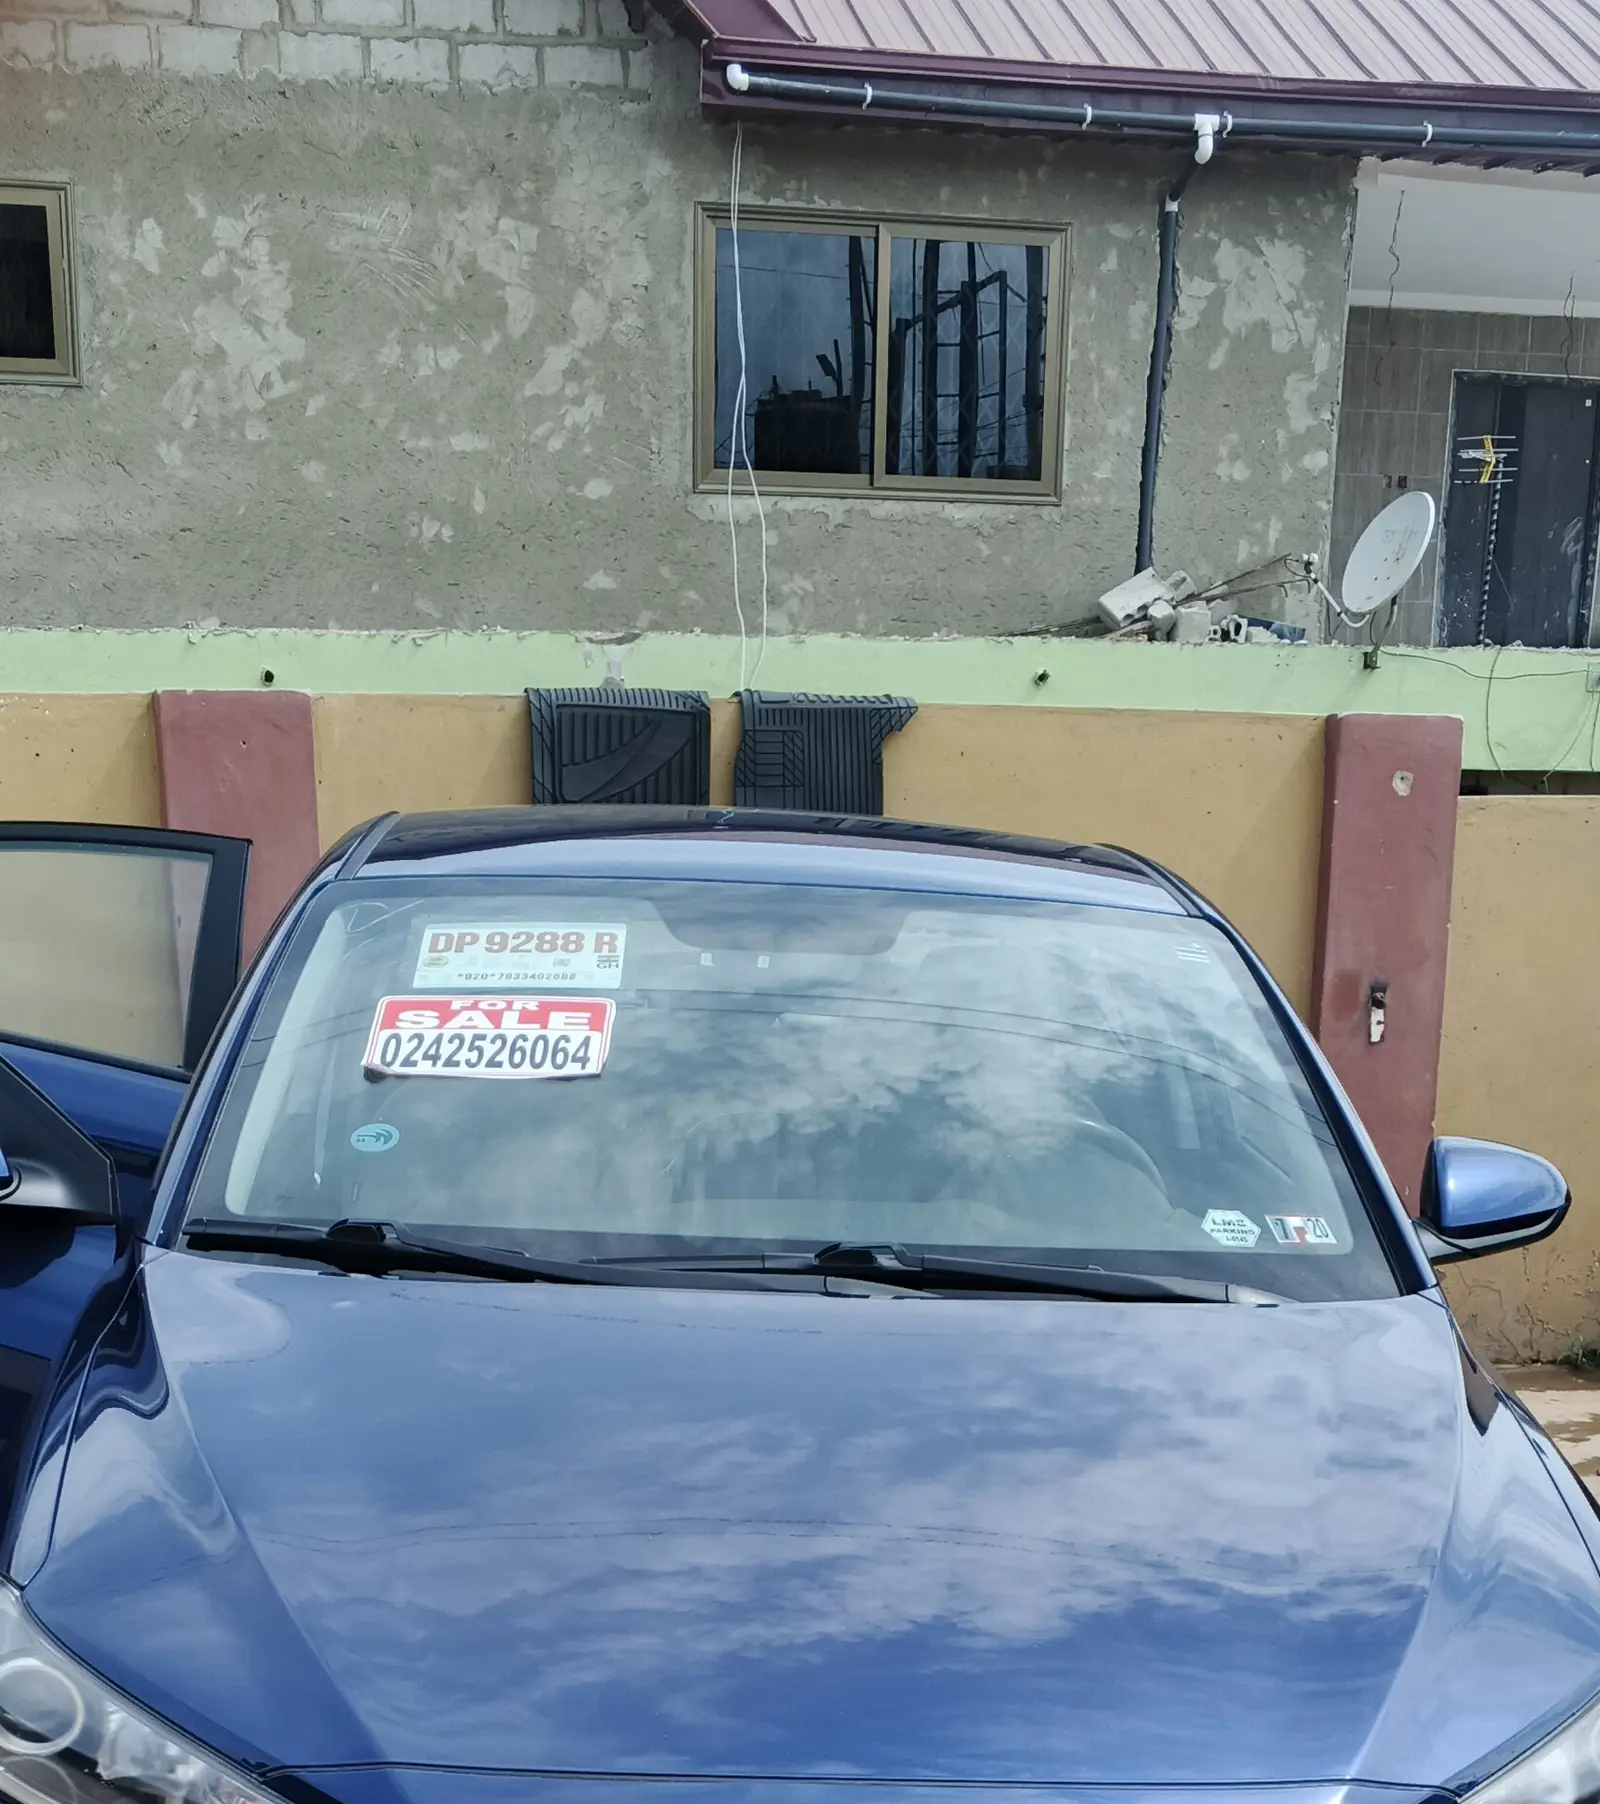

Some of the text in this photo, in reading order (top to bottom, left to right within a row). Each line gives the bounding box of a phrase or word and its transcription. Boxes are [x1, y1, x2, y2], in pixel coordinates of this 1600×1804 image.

[428, 931, 619, 953] DP 9288 R
[450, 1000, 540, 1011] FOR
[395, 1010, 592, 1031] SALE
[380, 1032, 592, 1070] 0242526064
[1306, 1218, 1329, 1238] 20
